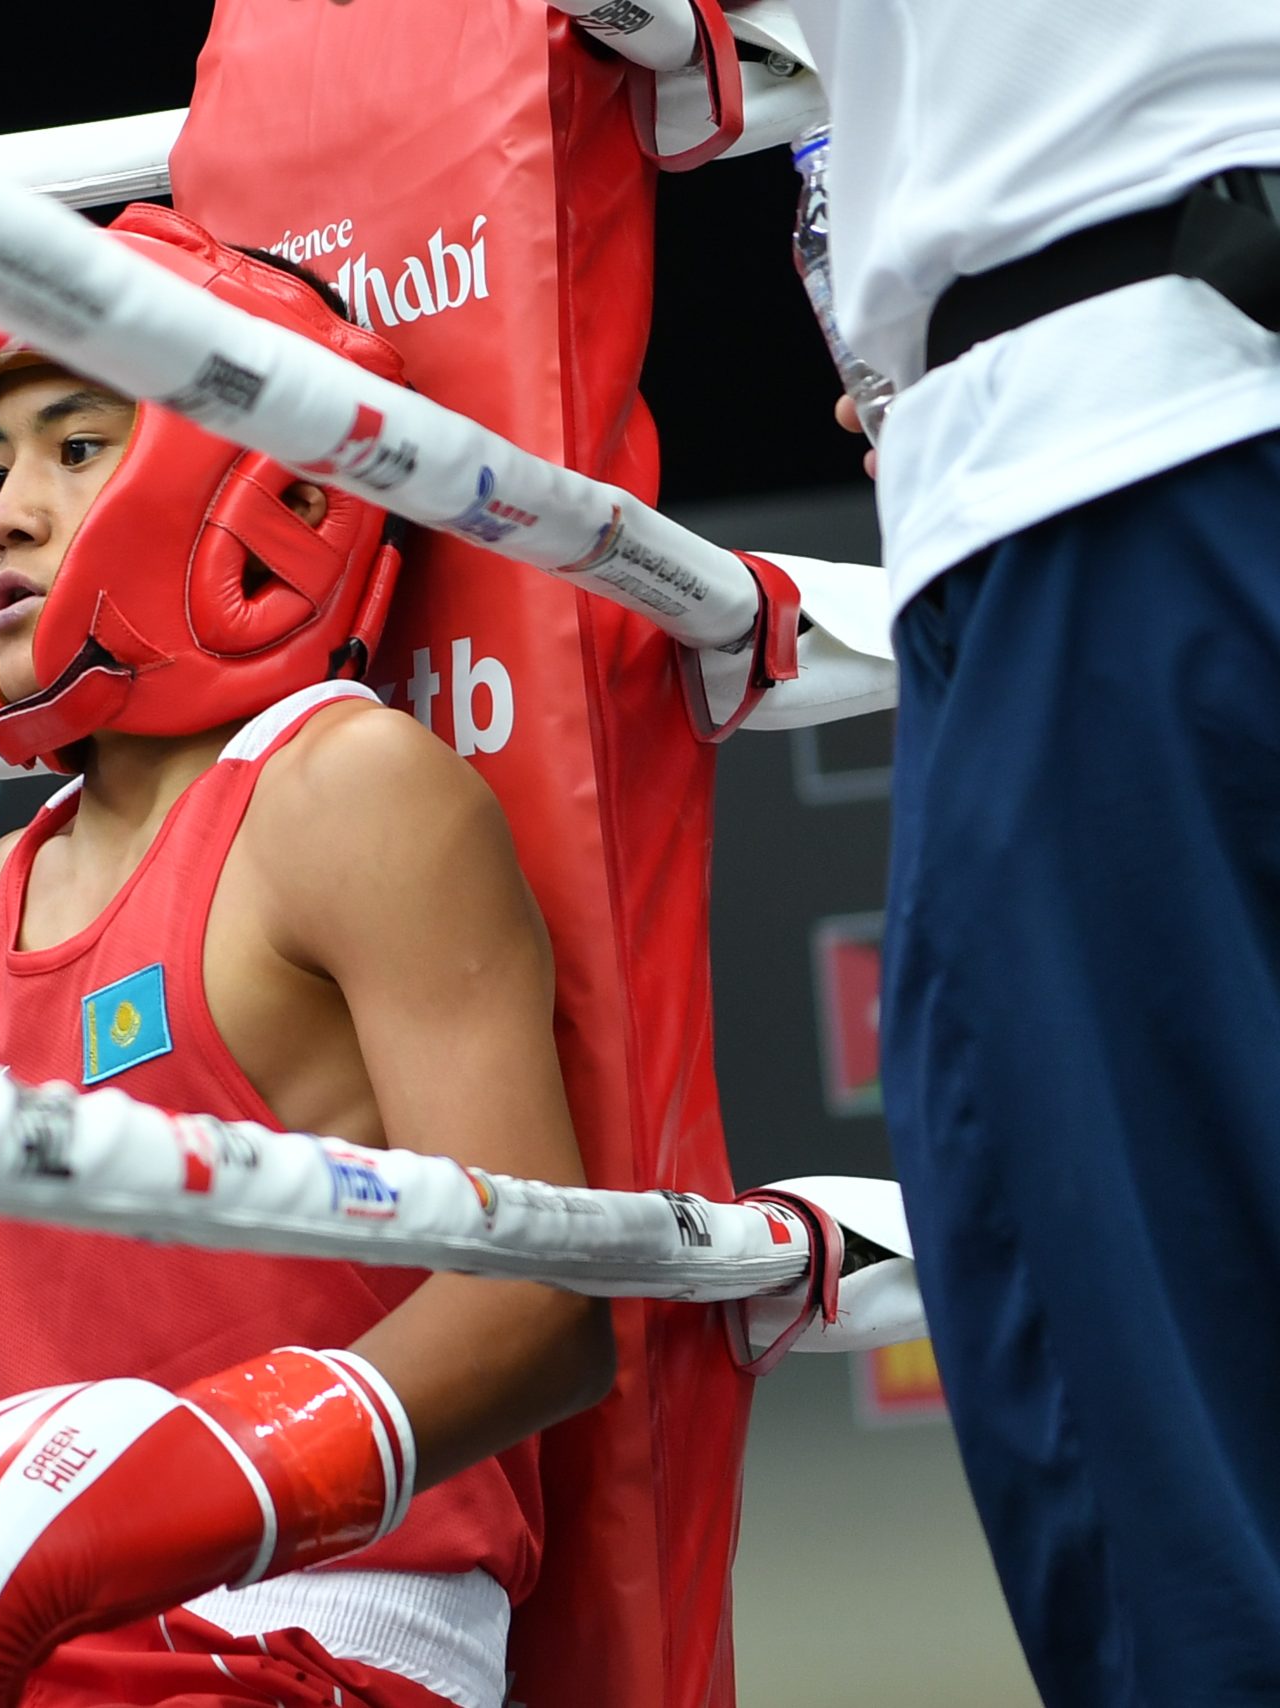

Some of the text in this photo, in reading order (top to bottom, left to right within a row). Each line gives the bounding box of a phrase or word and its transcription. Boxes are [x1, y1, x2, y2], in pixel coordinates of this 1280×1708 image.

[376, 636, 515, 758] tb
[22, 1424, 81, 1481] GREEN
[42, 1446, 98, 1493] HILL
